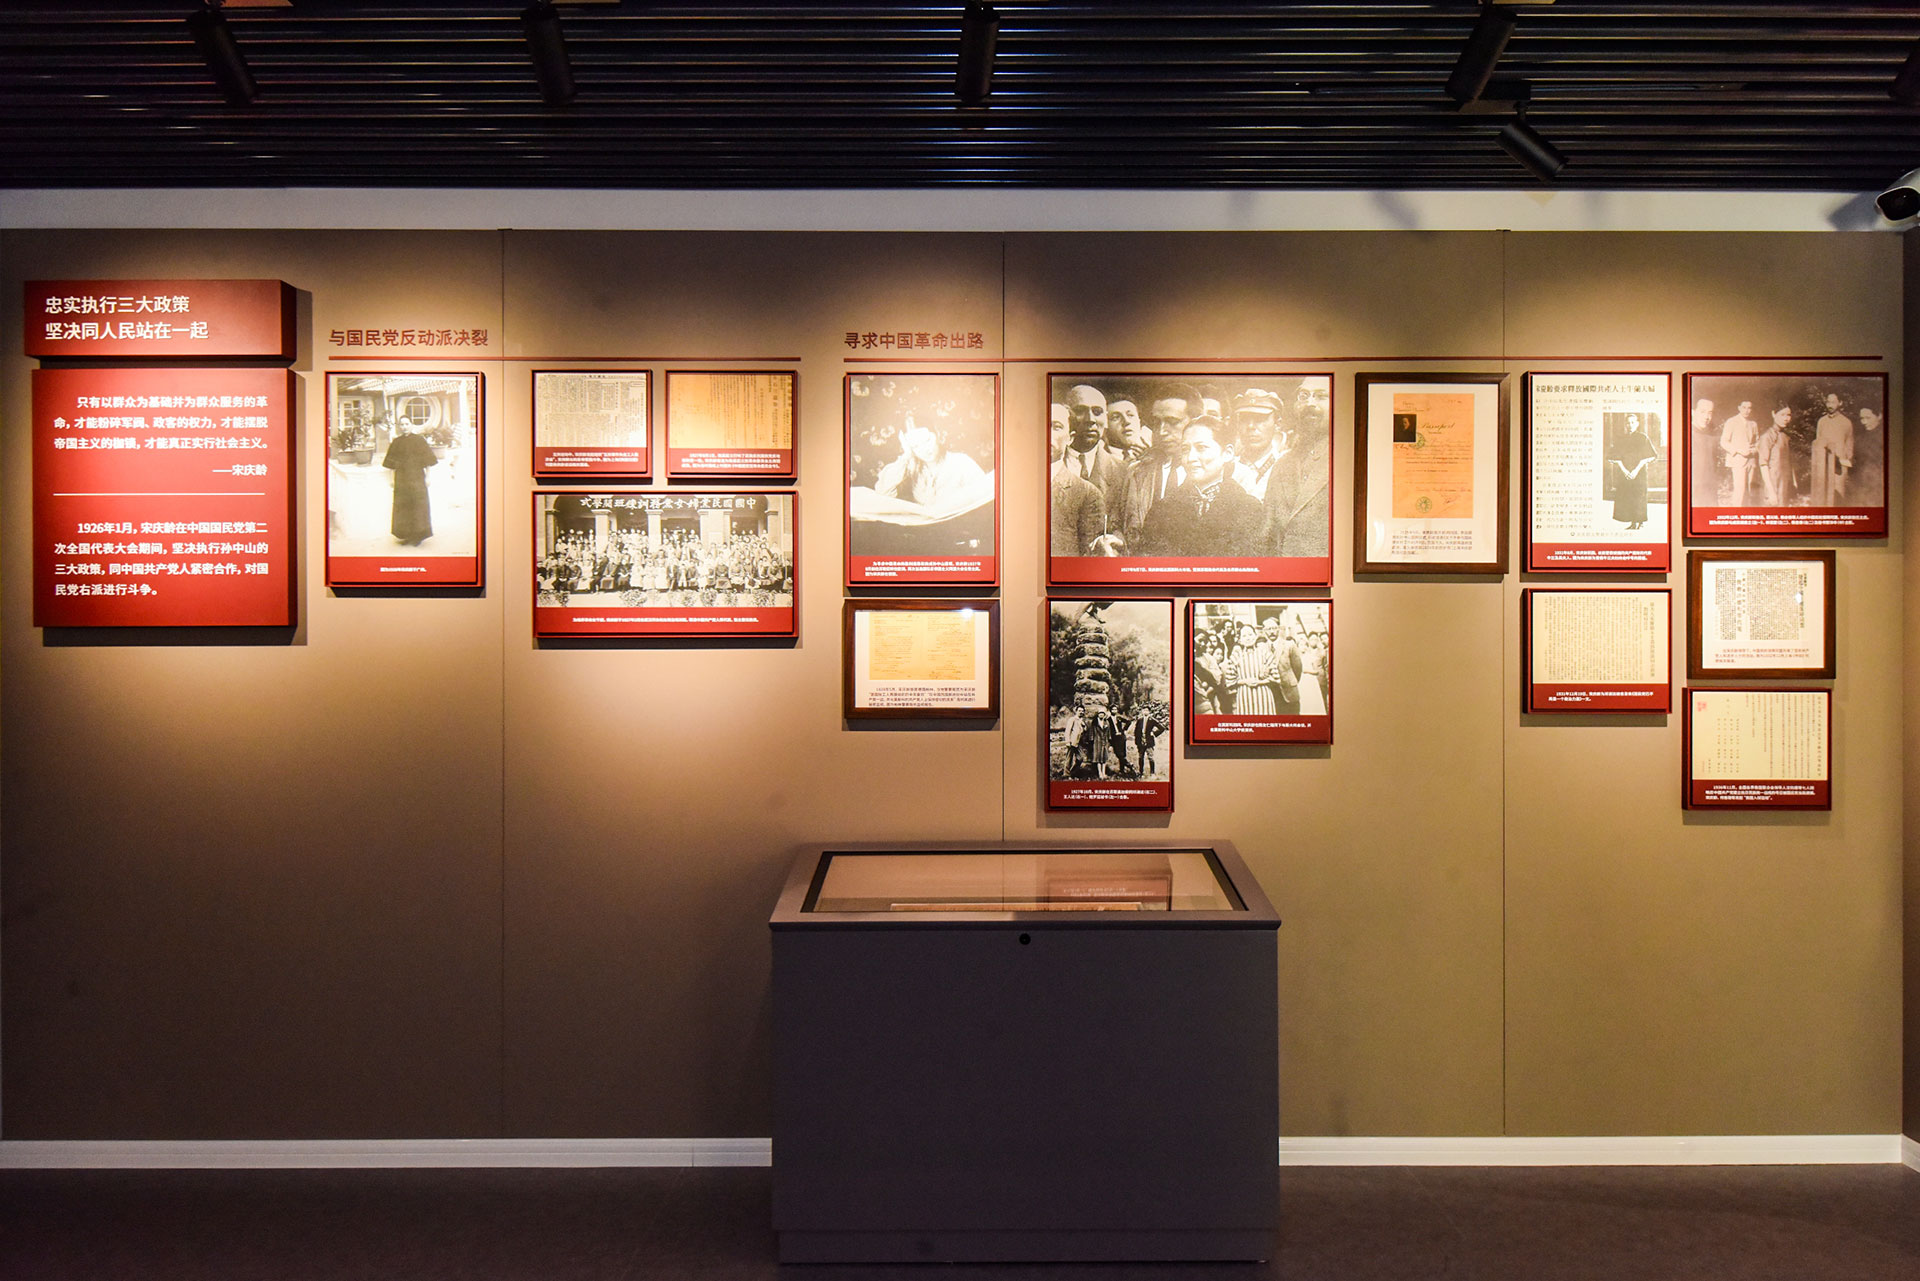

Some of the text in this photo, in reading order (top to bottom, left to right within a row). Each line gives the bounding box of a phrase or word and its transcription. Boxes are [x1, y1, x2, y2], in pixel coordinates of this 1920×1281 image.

[46, 296, 190, 314] 忠实执行三大政策
[46, 322, 209, 340] 坚决同人民站在一起
[329, 329, 488, 347] 与国民党反动派决裂
[844, 332, 984, 350] 寻求中国革命出路
[77, 396, 268, 408] 只有以群众为基础并为群众服务的革
[77, 521, 268, 534] 1926年1月，宋庆龄在中国国民党第二
[54, 542, 268, 555] 次全国代表大会期间，坚决执行孙中山的
[55, 562, 268, 576] 三大政策，同中国共产党人紧密合作，对国
[55, 583, 158, 596] 民党右派进行斗争。
